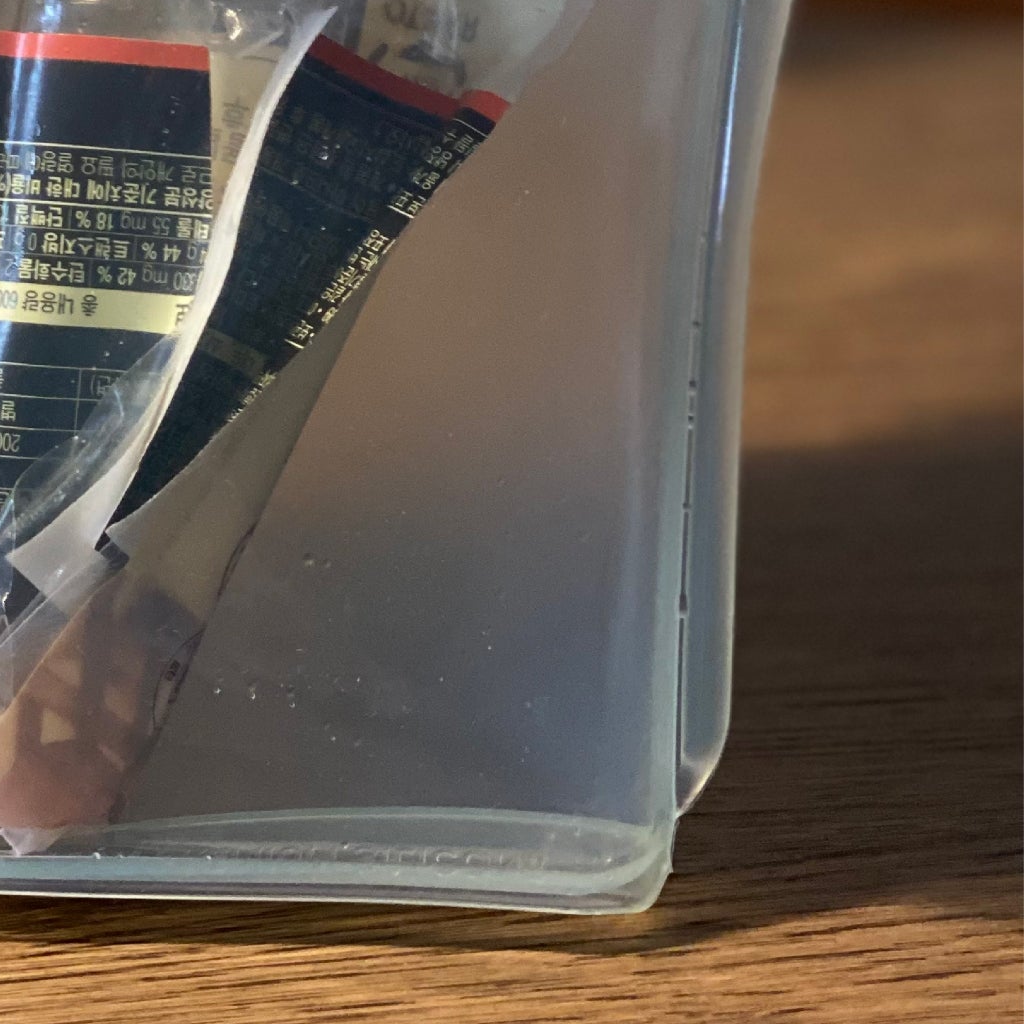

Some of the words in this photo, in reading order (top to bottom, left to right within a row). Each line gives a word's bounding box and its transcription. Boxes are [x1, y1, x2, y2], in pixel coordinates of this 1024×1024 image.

[46, 176, 80, 199] 대한
[14, 203, 63, 227] 단백질
[75, 210, 91, 229] %
[96, 211, 114, 231] 18
[120, 210, 147, 230] mg
[152, 216, 171, 235] 55
[42, 231, 129, 259] 트랜스지방
[141, 242, 157, 260] %
[162, 244, 182, 262] 44
[18, 257, 85, 283] 탄수화물
[96, 265, 113, 283] %
[118, 267, 136, 286] 42
[142, 262, 167, 283] mg
[22, 290, 73, 315] 내용량
[80, 294, 98, 316] 총
